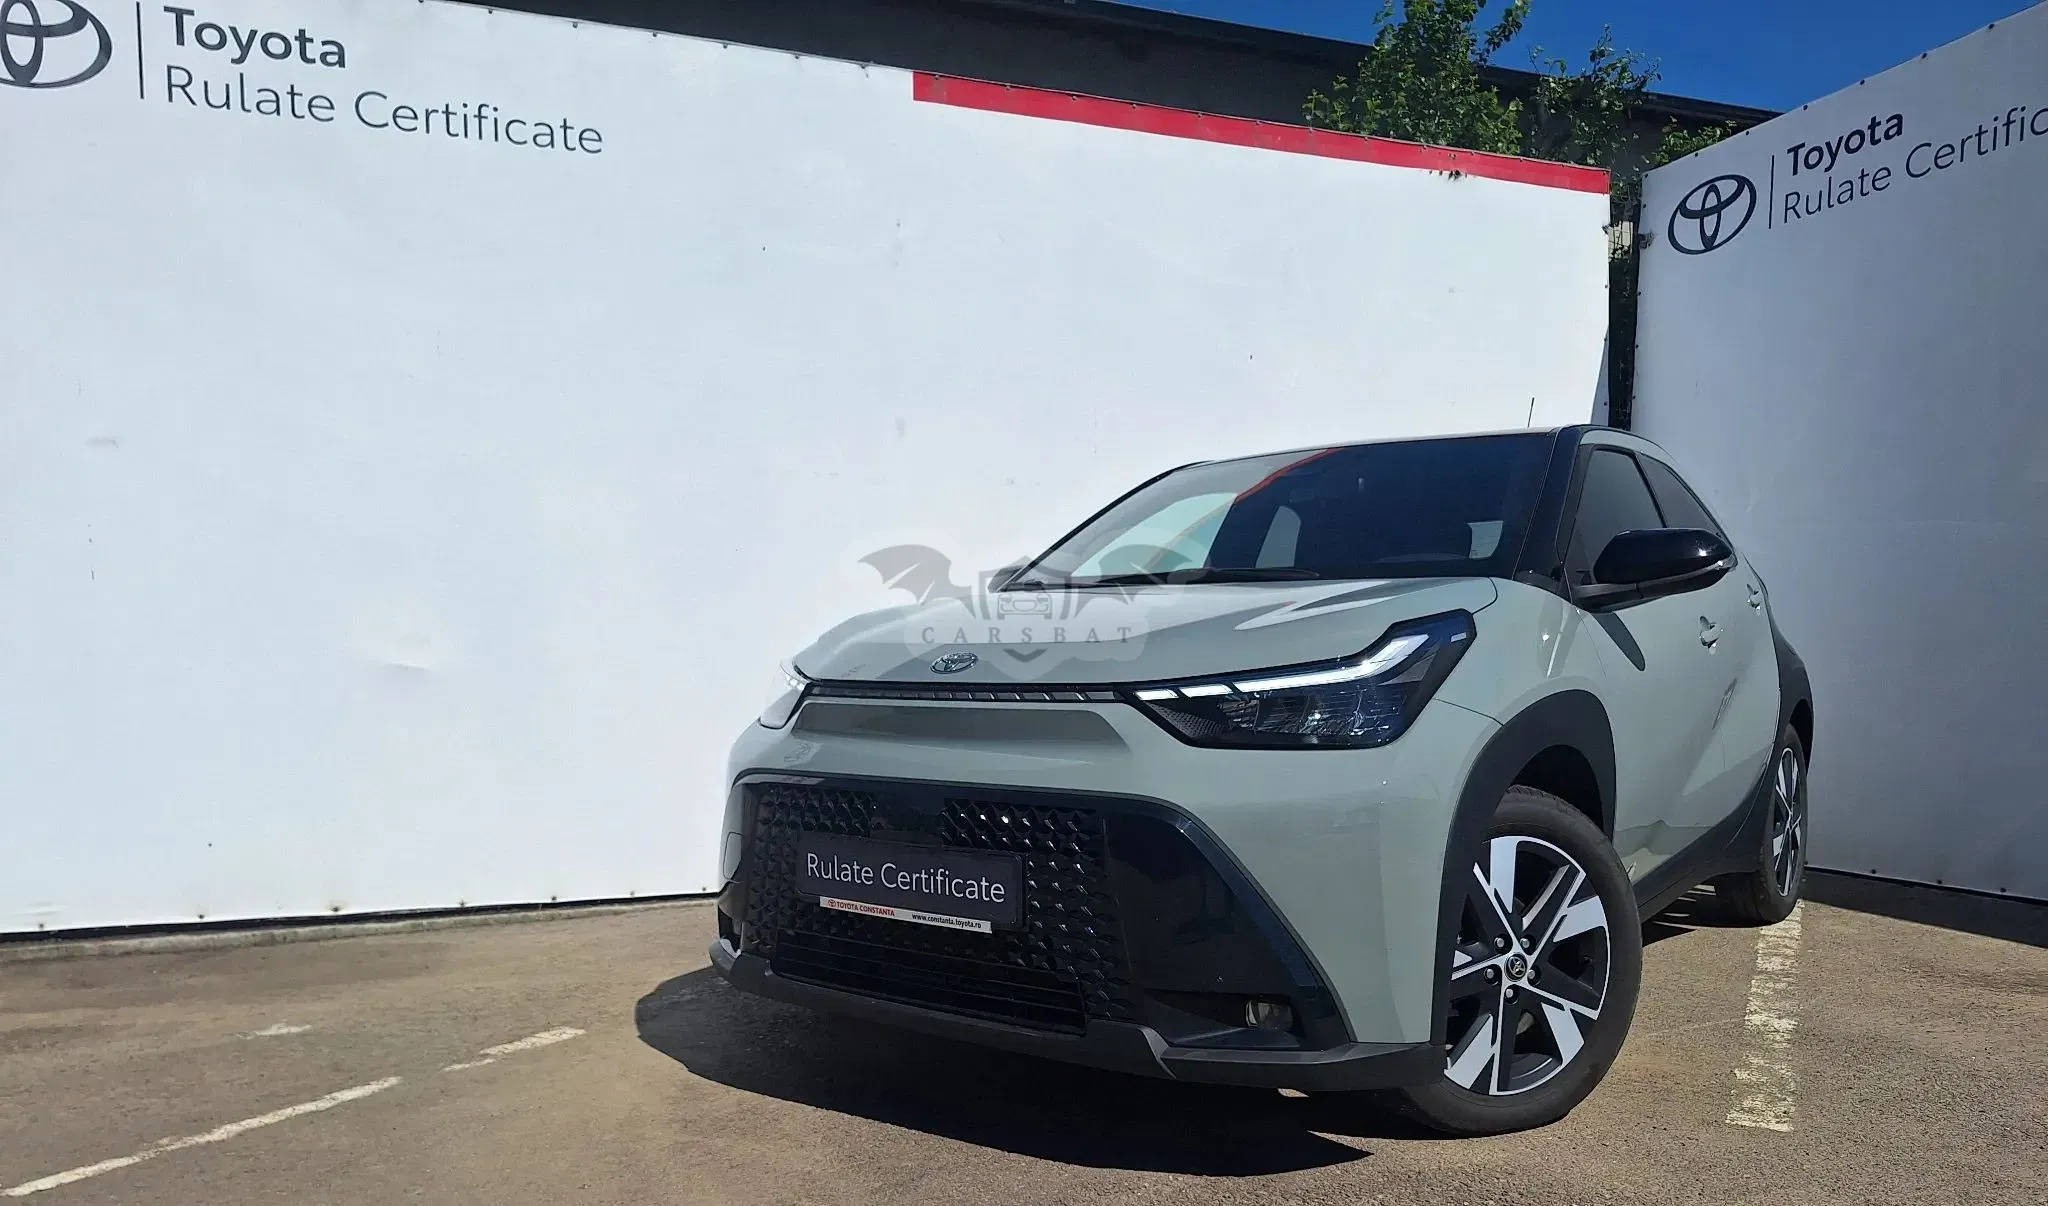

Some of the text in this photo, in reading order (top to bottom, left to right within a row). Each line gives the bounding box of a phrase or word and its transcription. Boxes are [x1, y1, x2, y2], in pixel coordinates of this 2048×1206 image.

[164, 6, 347, 68] Toyota
[166, 65, 603, 154] Rulate Certificate
[1787, 113, 1904, 176] Toyota
[1784, 167, 1892, 224] Rulate
[807, 853, 1005, 902] Rulate Certificate
[836, 901, 982, 929] TOYOTA CONSTANTA www.constanta.toyota.ro
